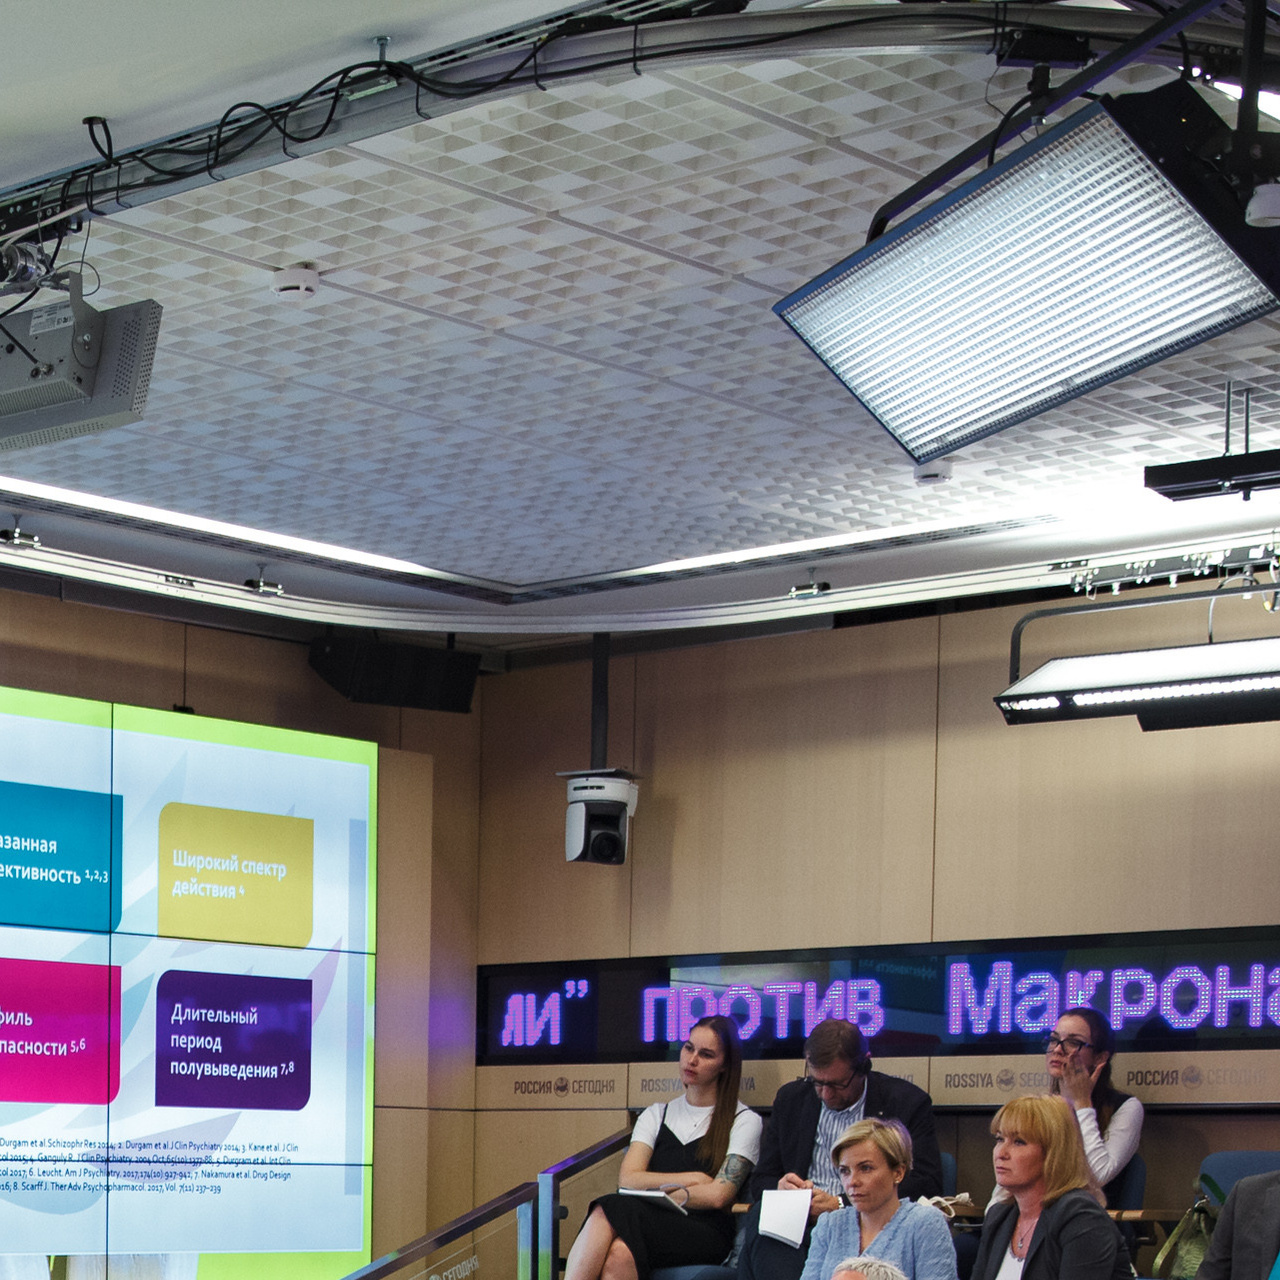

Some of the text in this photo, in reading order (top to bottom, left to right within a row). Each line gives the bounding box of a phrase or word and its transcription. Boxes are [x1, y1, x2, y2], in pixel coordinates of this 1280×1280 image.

[173, 849, 287, 882] Широкий спектр
[85, 869, 109, 884] 1,2,3
[172, 877, 236, 899] действия
[171, 1003, 257, 1025] Длительный
[70, 1038, 86, 1053] 5,6
[171, 1034, 222, 1053] период
[170, 1061, 295, 1080] полувыведения 7,8
[1127, 1070, 1178, 1086] РОССИЯ
[514, 1080, 615, 1095] РОССИЯ СЕГОДНЯ
[641, 1078, 683, 1092] ROSSIYA
[945, 1073, 993, 1088] ROSSIYA
[0, 1138, 28, 1149] Durgam
[48, 1139, 83, 1149] Schizophr
[84, 1140, 96, 1148] Res
[125, 1140, 152, 1151] Durgam
[154, 1141, 161, 1150] et
[174, 1141, 188, 1150] Clin
[189, 1141, 223, 1152] Psychiatry
[249, 1143, 265, 1152] Kane
[266, 1144, 273, 1152] et
[286, 1143, 298, 1152] Clin
[65, 1168, 77, 1177] Am
[201, 1170, 235, 1179] Nakamura
[236, 1171, 243, 1179] et
[252, 1170, 268, 1181] Drug
[269, 1170, 291, 1181] Design
[21, 1181, 44, 1191] Scarff
[50, 1182, 67, 1191] Ther
[67, 1182, 81, 1191] Adv
